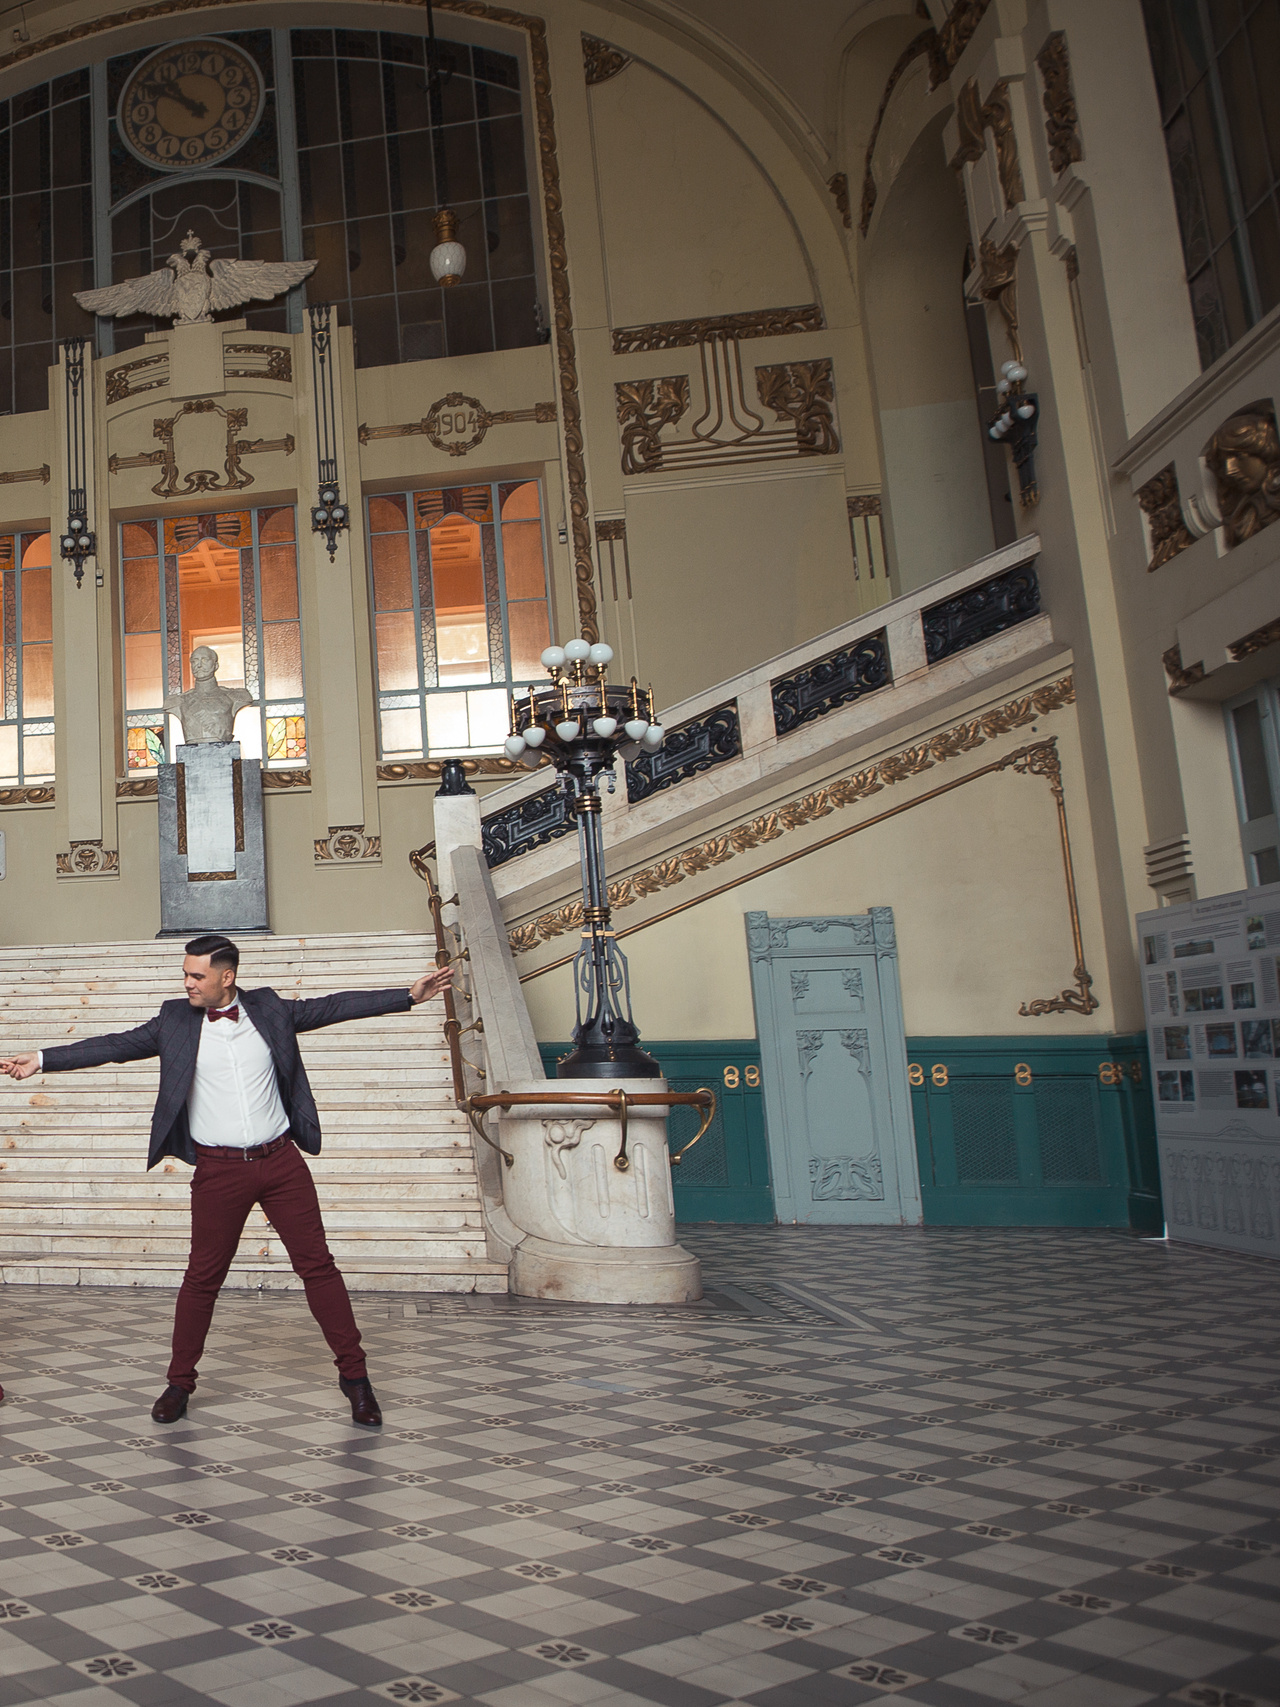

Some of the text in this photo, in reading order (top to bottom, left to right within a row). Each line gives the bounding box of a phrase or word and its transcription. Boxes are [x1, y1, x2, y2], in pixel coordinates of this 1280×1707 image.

[181, 54, 197, 73] 12
[210, 57, 216, 73] 1
[225, 67, 237, 86] 2
[233, 88, 245, 106] 3
[137, 105, 149, 122] 9
[226, 111, 241, 128] 4
[144, 125, 156, 142] 8
[210, 130, 222, 147] 5
[162, 138, 173, 155] 7
[186, 139, 198, 157] 6
[434, 411, 478, 437] 1904
